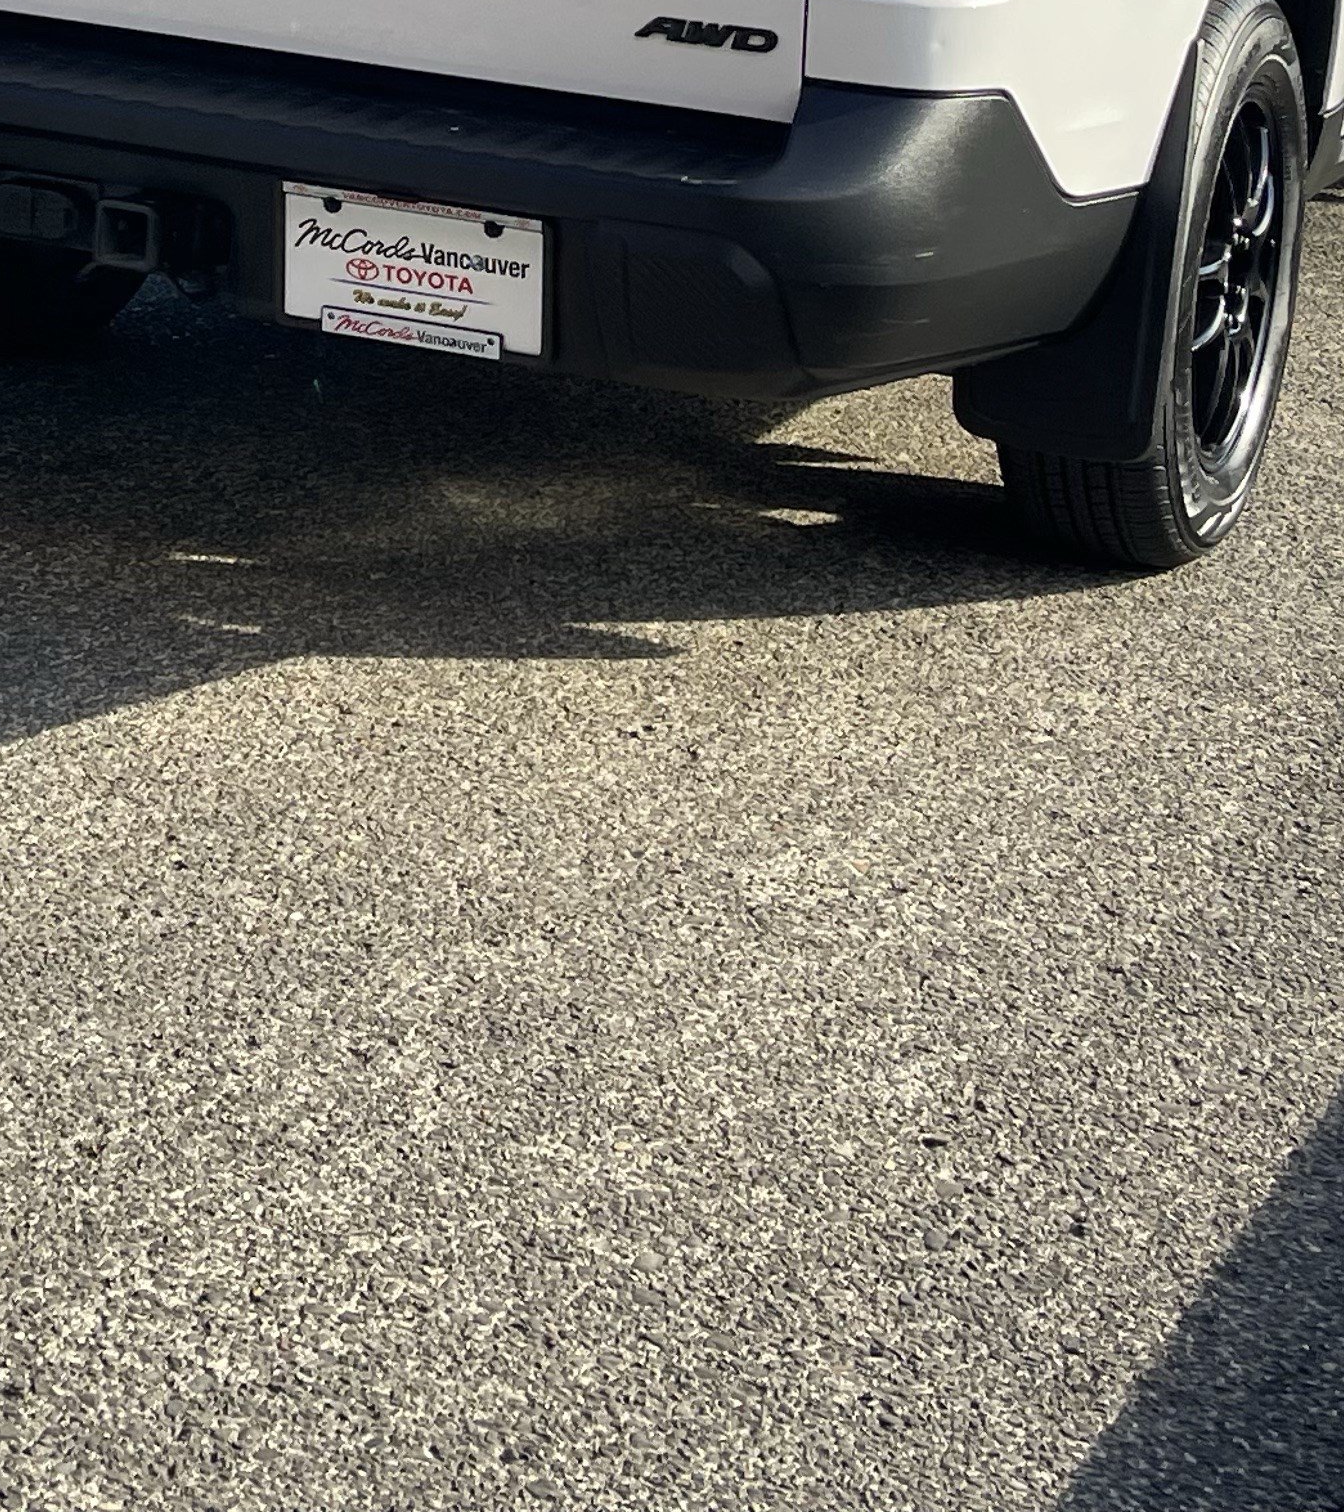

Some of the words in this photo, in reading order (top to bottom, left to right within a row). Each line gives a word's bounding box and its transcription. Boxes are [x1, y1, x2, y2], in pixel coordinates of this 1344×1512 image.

[634, 16, 779, 53] AWD
[421, 243, 530, 279] Vancouver
[383, 264, 474, 294] TOYOTA
[416, 330, 488, 354] Vancouver
